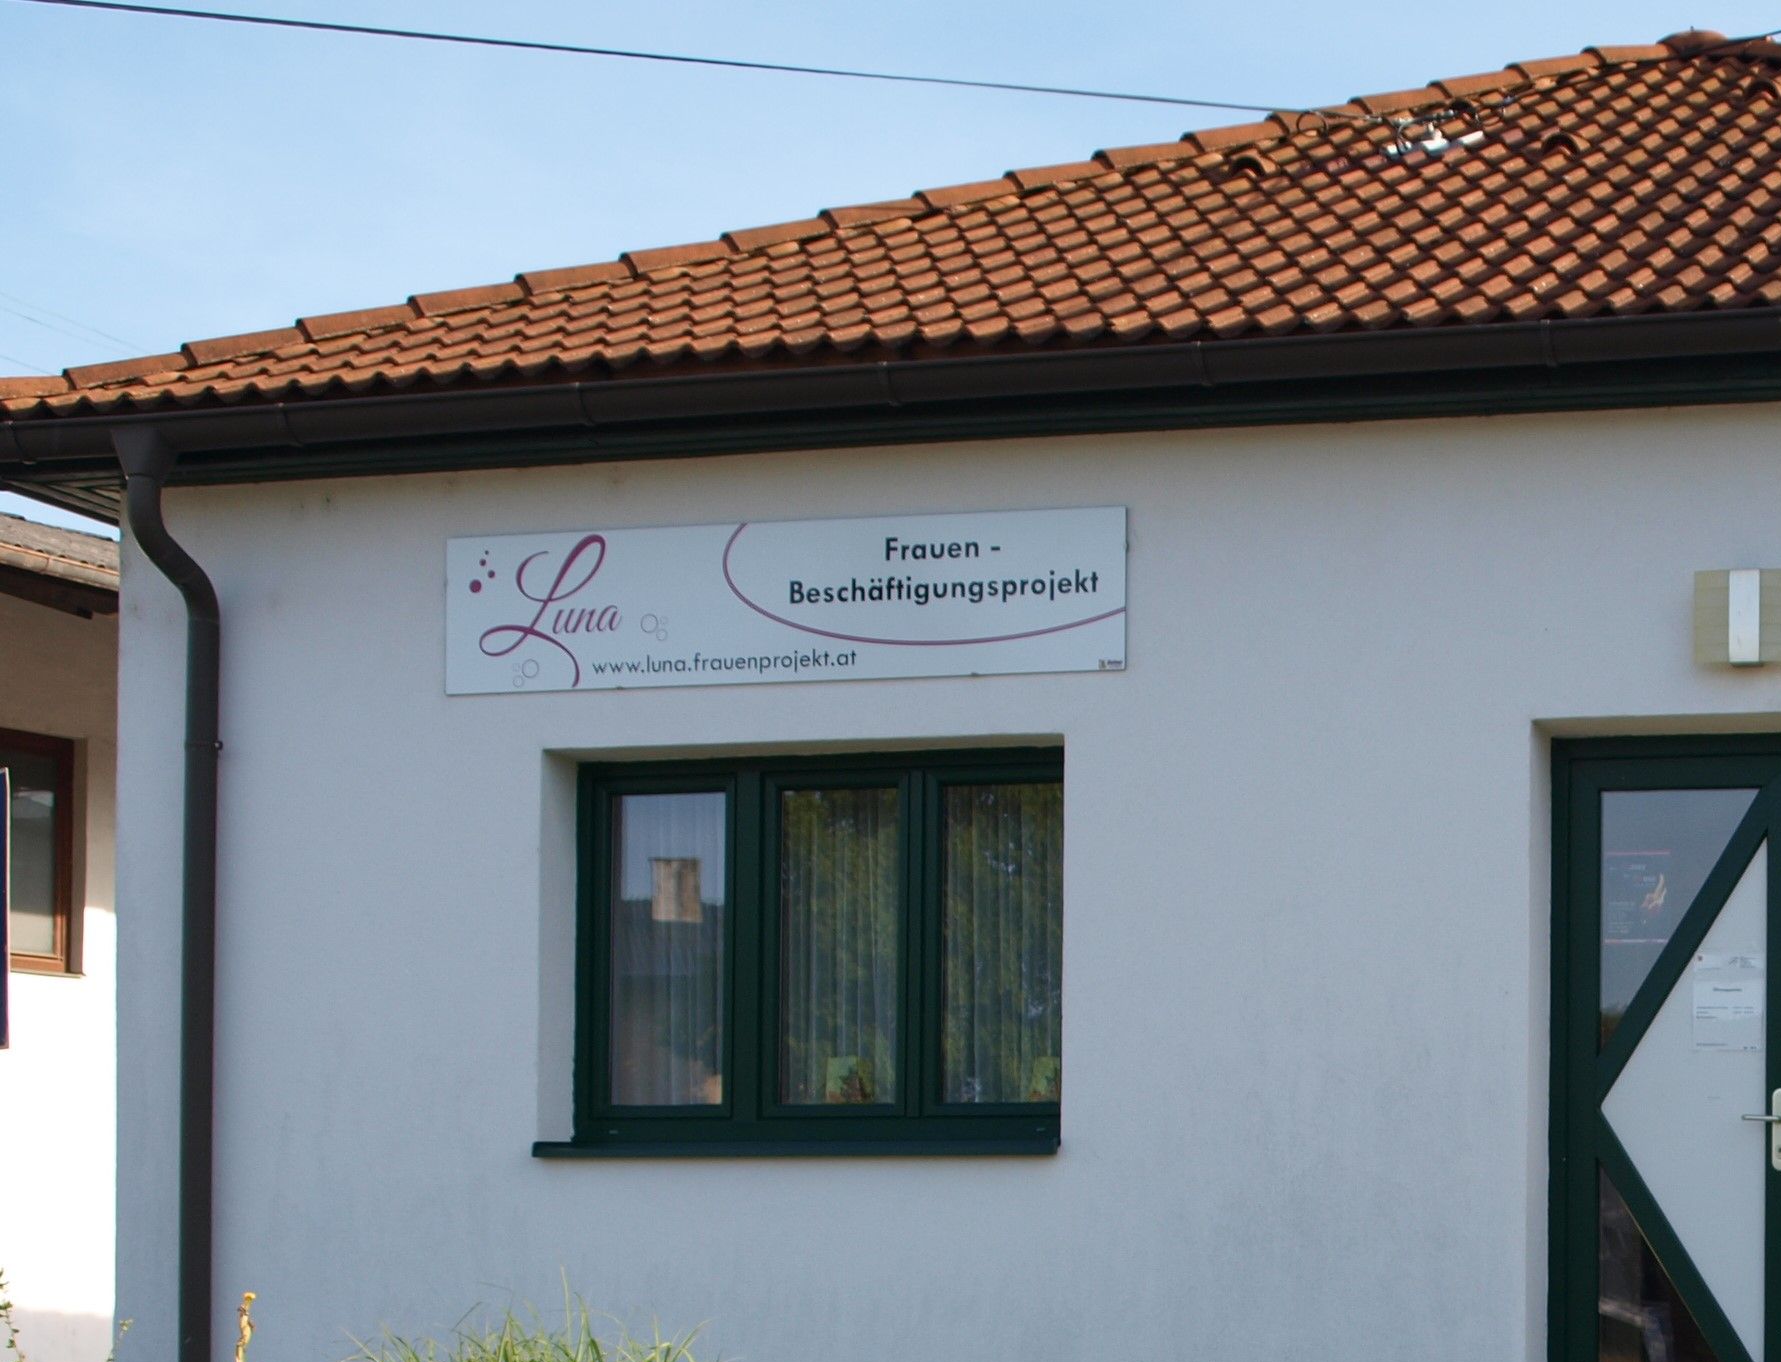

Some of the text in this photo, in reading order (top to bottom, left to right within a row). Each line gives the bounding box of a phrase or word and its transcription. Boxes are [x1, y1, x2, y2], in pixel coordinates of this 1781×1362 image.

[885, 537, 979, 561] Frauen
[789, 569, 1099, 605] Beschäftigungsprojekt
[479, 533, 623, 688] Luna
[592, 649, 857, 674] www.luna.frauenprojekt.at
